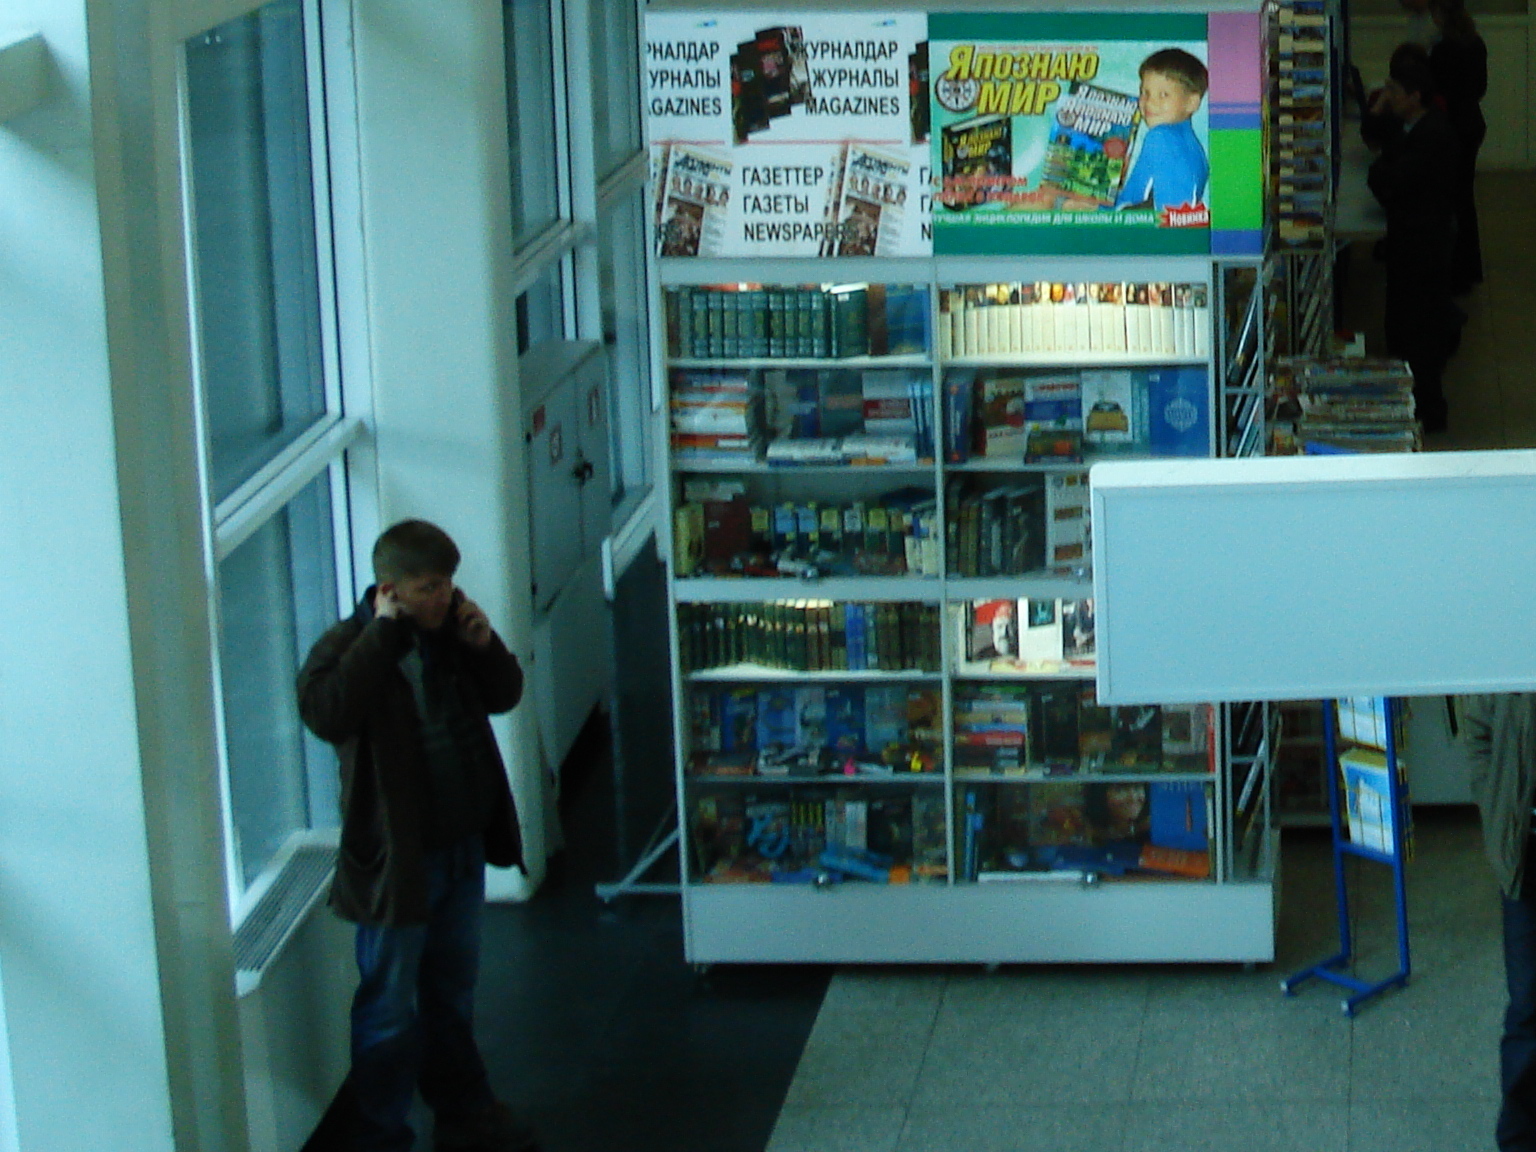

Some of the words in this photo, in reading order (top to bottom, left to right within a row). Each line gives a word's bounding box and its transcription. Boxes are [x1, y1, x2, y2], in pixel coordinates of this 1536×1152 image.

[945, 45, 975, 80] Я
[973, 53, 1099, 80] ПОЗНАЮ
[812, 68, 899, 88] ЖУРНАЛЫ
[649, 96, 722, 116] GAZINES
[805, 96, 900, 115] MAGAZINES
[977, 80, 1061, 115] МИР
[742, 167, 824, 186] ГАЗЕТТЕР
[743, 194, 809, 214] ГАЗЕТЫ
[744, 222, 853, 242] NEWSPAPER
